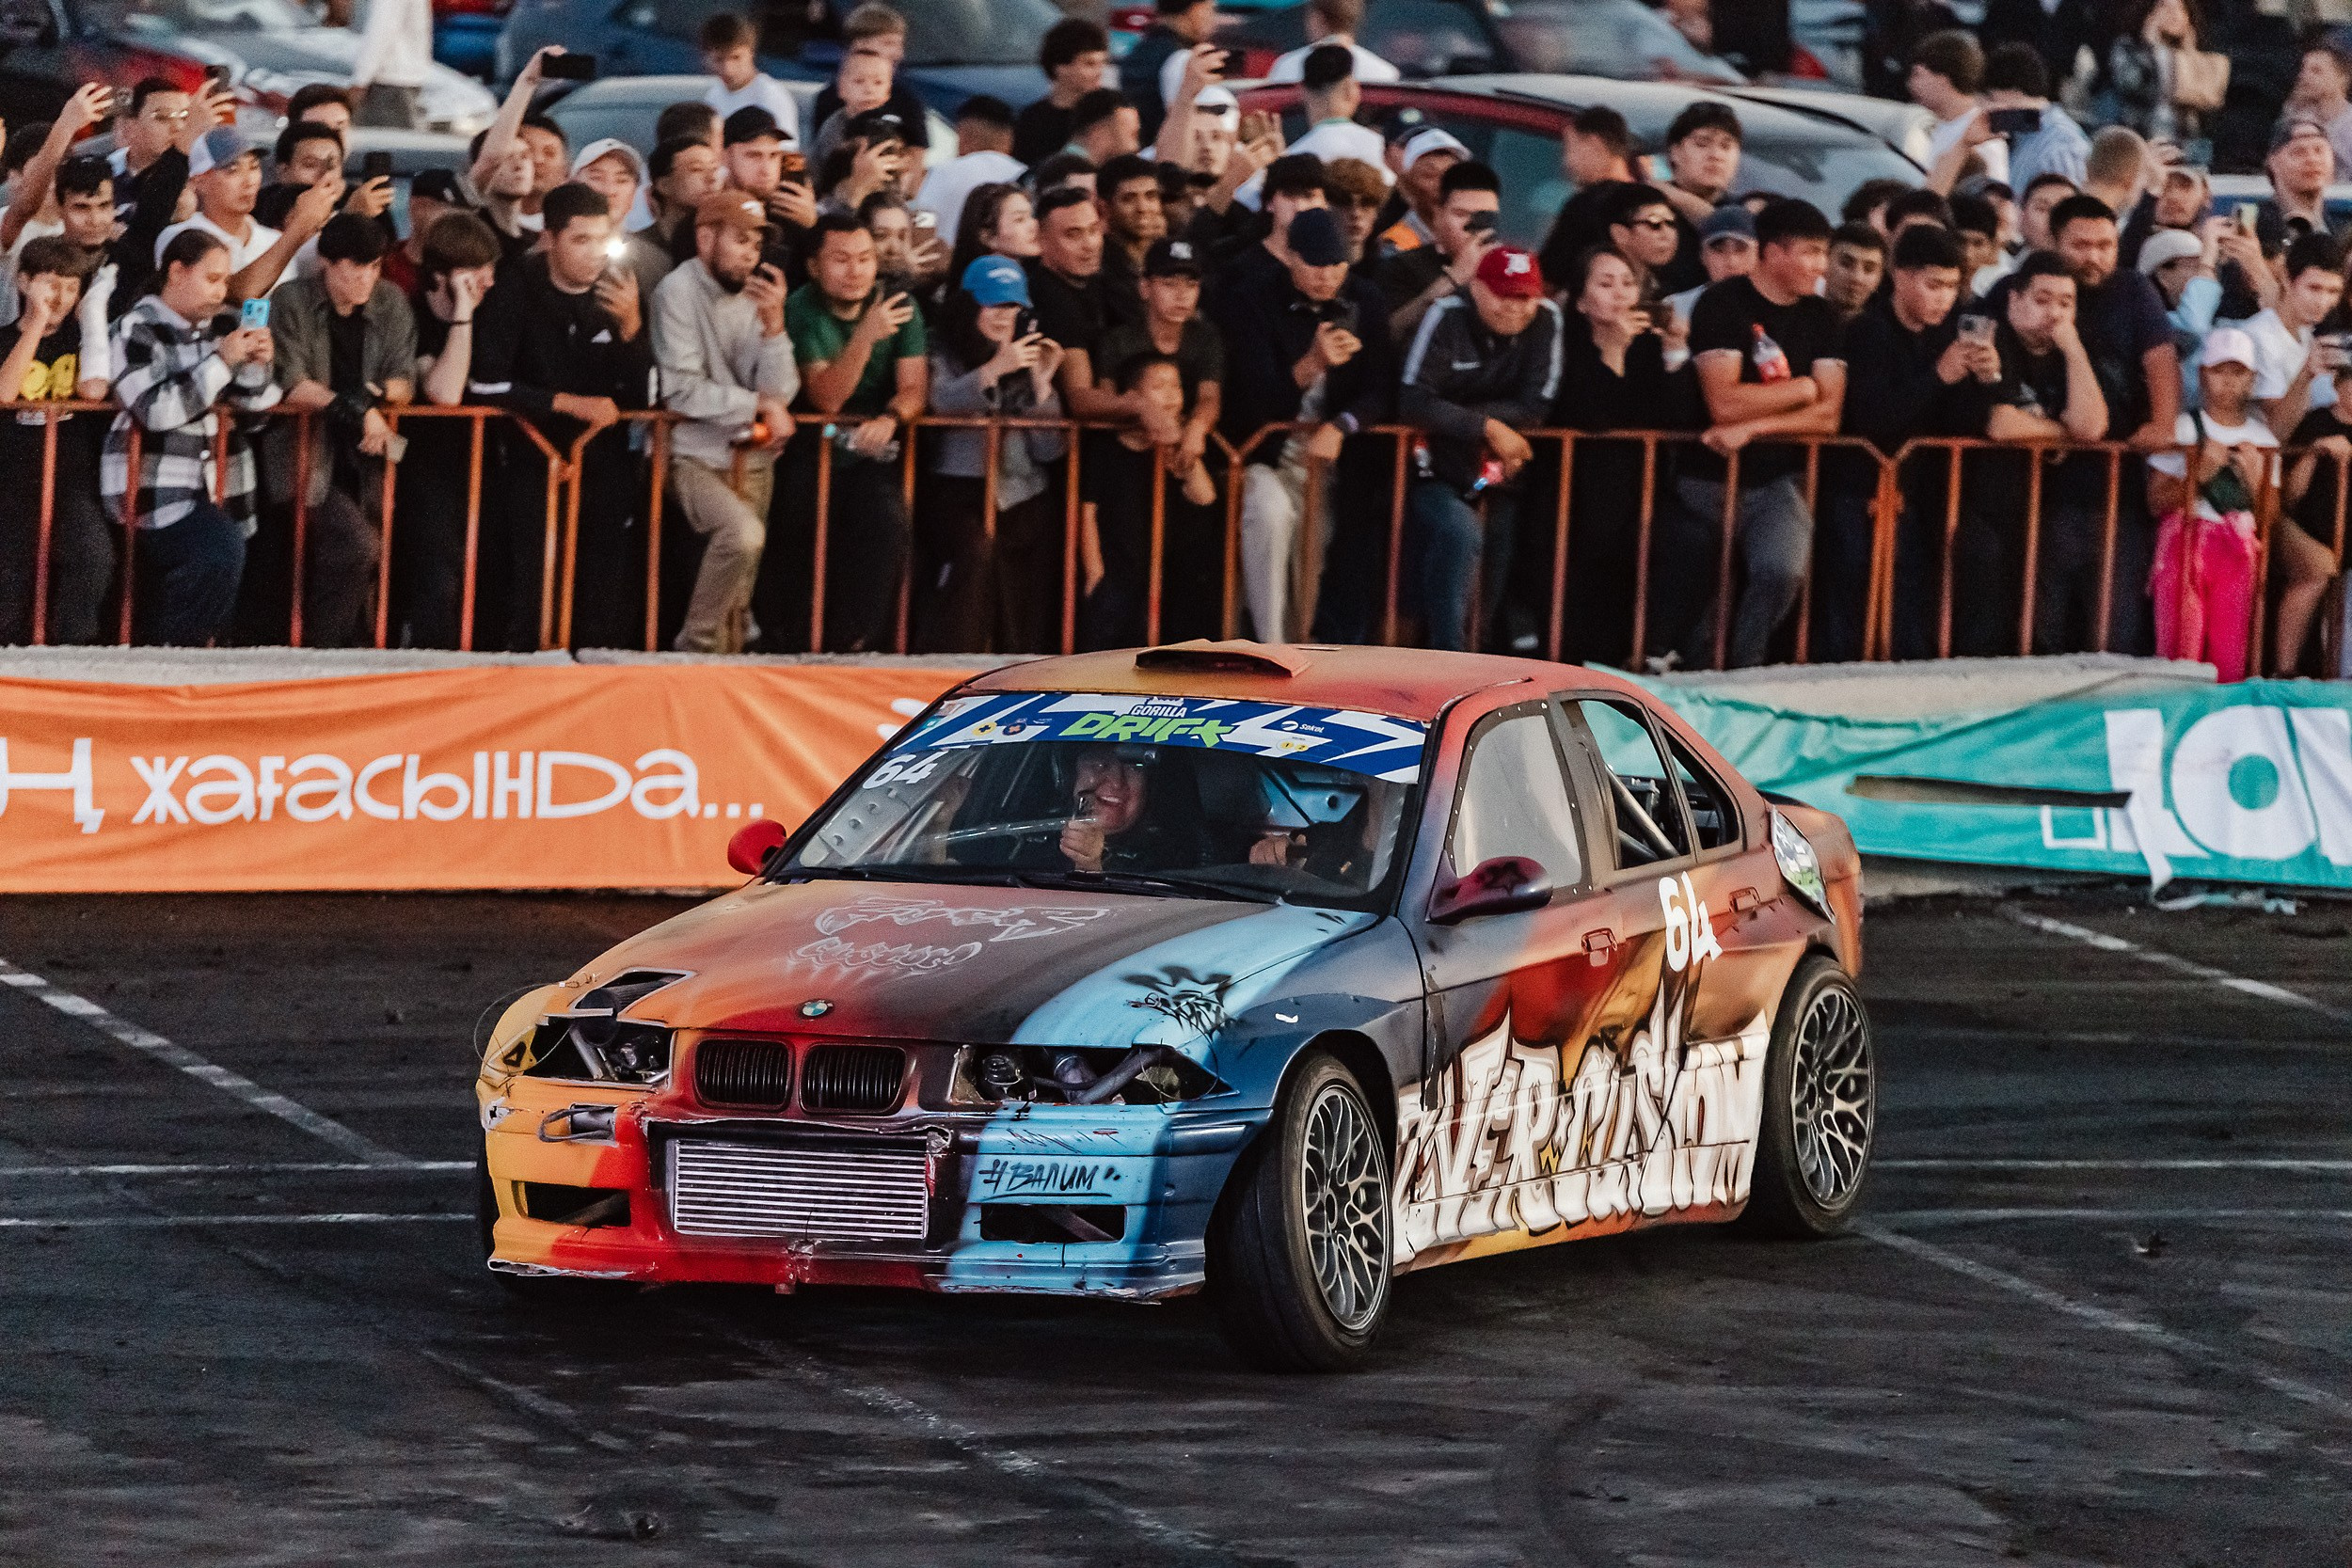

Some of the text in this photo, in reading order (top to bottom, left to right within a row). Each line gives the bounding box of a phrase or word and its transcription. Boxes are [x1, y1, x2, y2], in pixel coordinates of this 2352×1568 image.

[1131, 705, 1187, 718] GORILLA
[863, 751, 949, 789] 64
[1658, 870, 1724, 973] 64
